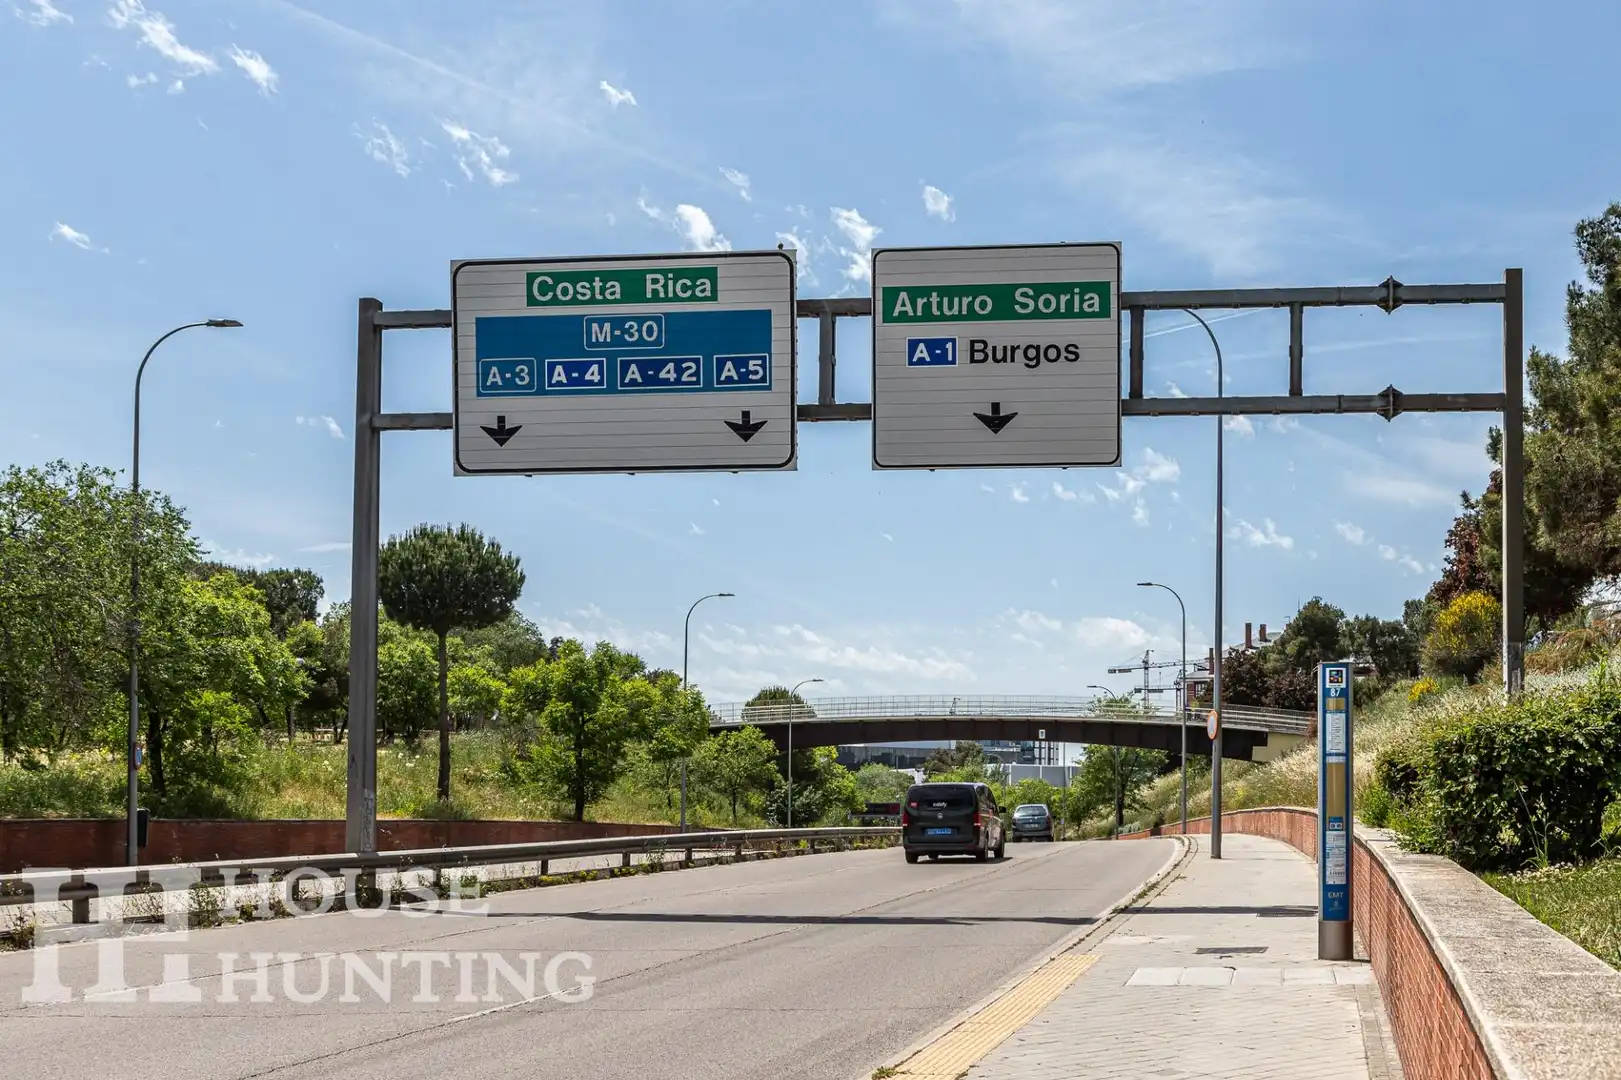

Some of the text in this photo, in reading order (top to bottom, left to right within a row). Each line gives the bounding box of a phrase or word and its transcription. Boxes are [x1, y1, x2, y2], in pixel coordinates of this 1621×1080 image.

[532, 273, 712, 301] Costa Rica
[892, 287, 1100, 317] Arturo Soria
[591, 320, 659, 343] M-30
[912, 339, 1081, 369] A-1 Burgos
[486, 359, 764, 386] A-3 A-4 A-42 A-5
[1330, 688, 1341, 697] 87
